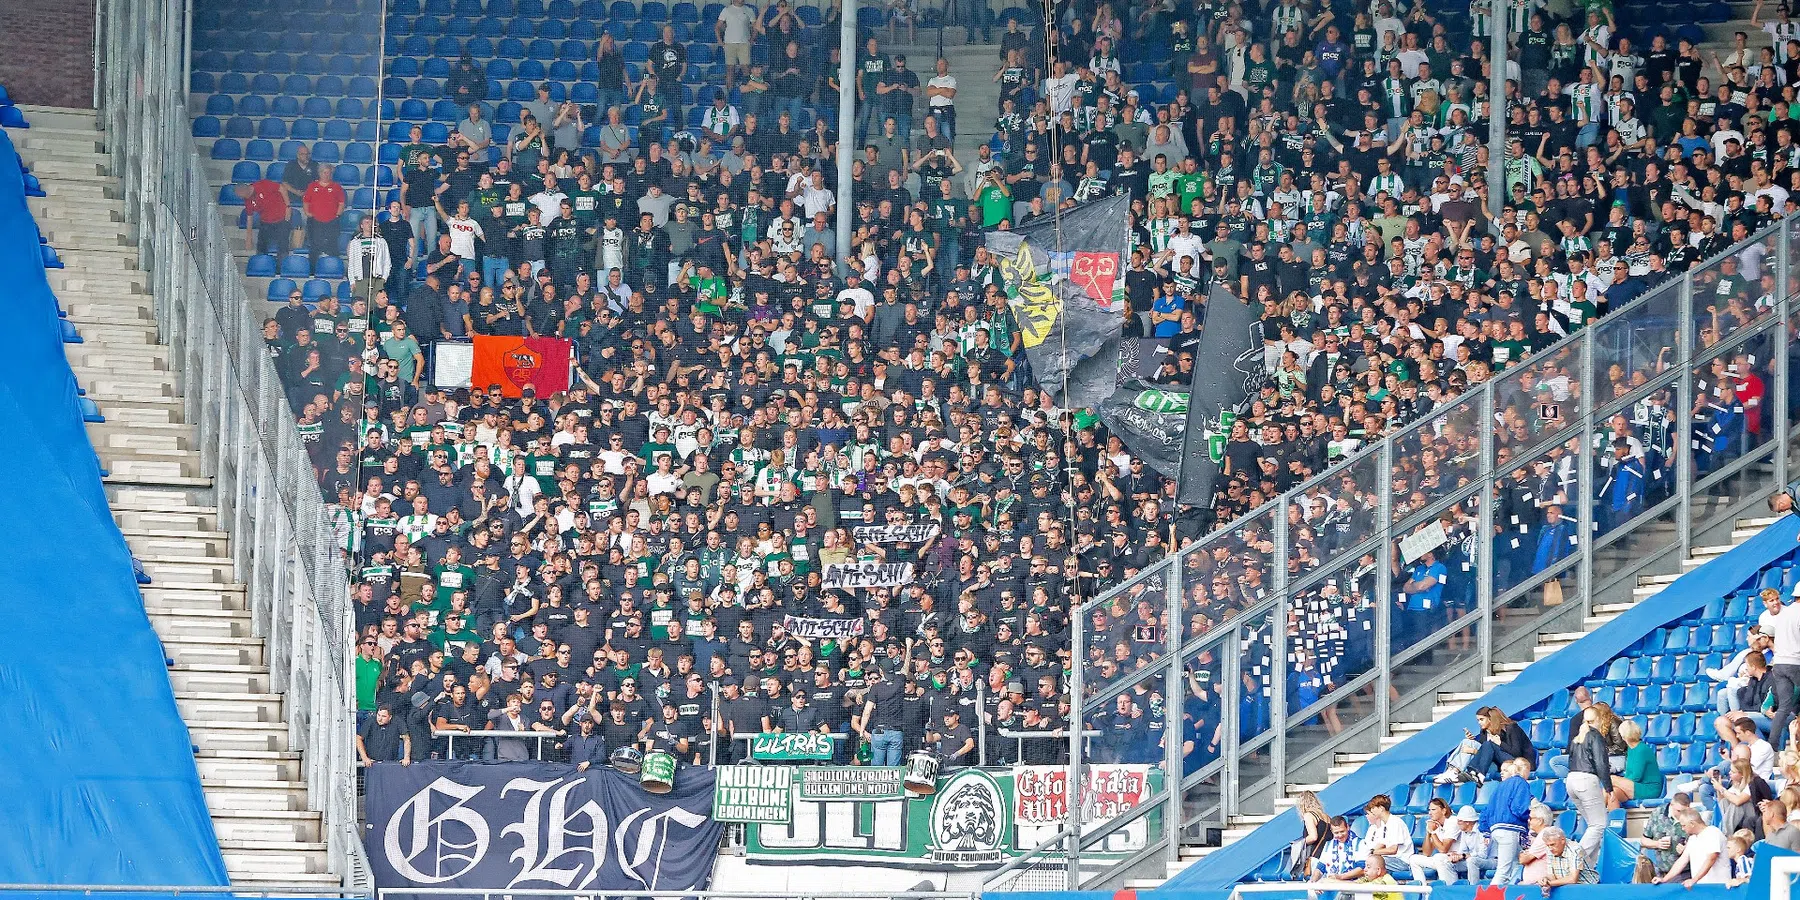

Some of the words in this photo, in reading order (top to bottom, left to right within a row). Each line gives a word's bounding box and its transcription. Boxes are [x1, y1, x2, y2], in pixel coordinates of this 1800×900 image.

[754, 733, 832, 755] ULTRAS
[720, 765, 791, 789] NOORD
[719, 787, 788, 807] TRIBUNE
[717, 805, 788, 820] GRONINGEN
